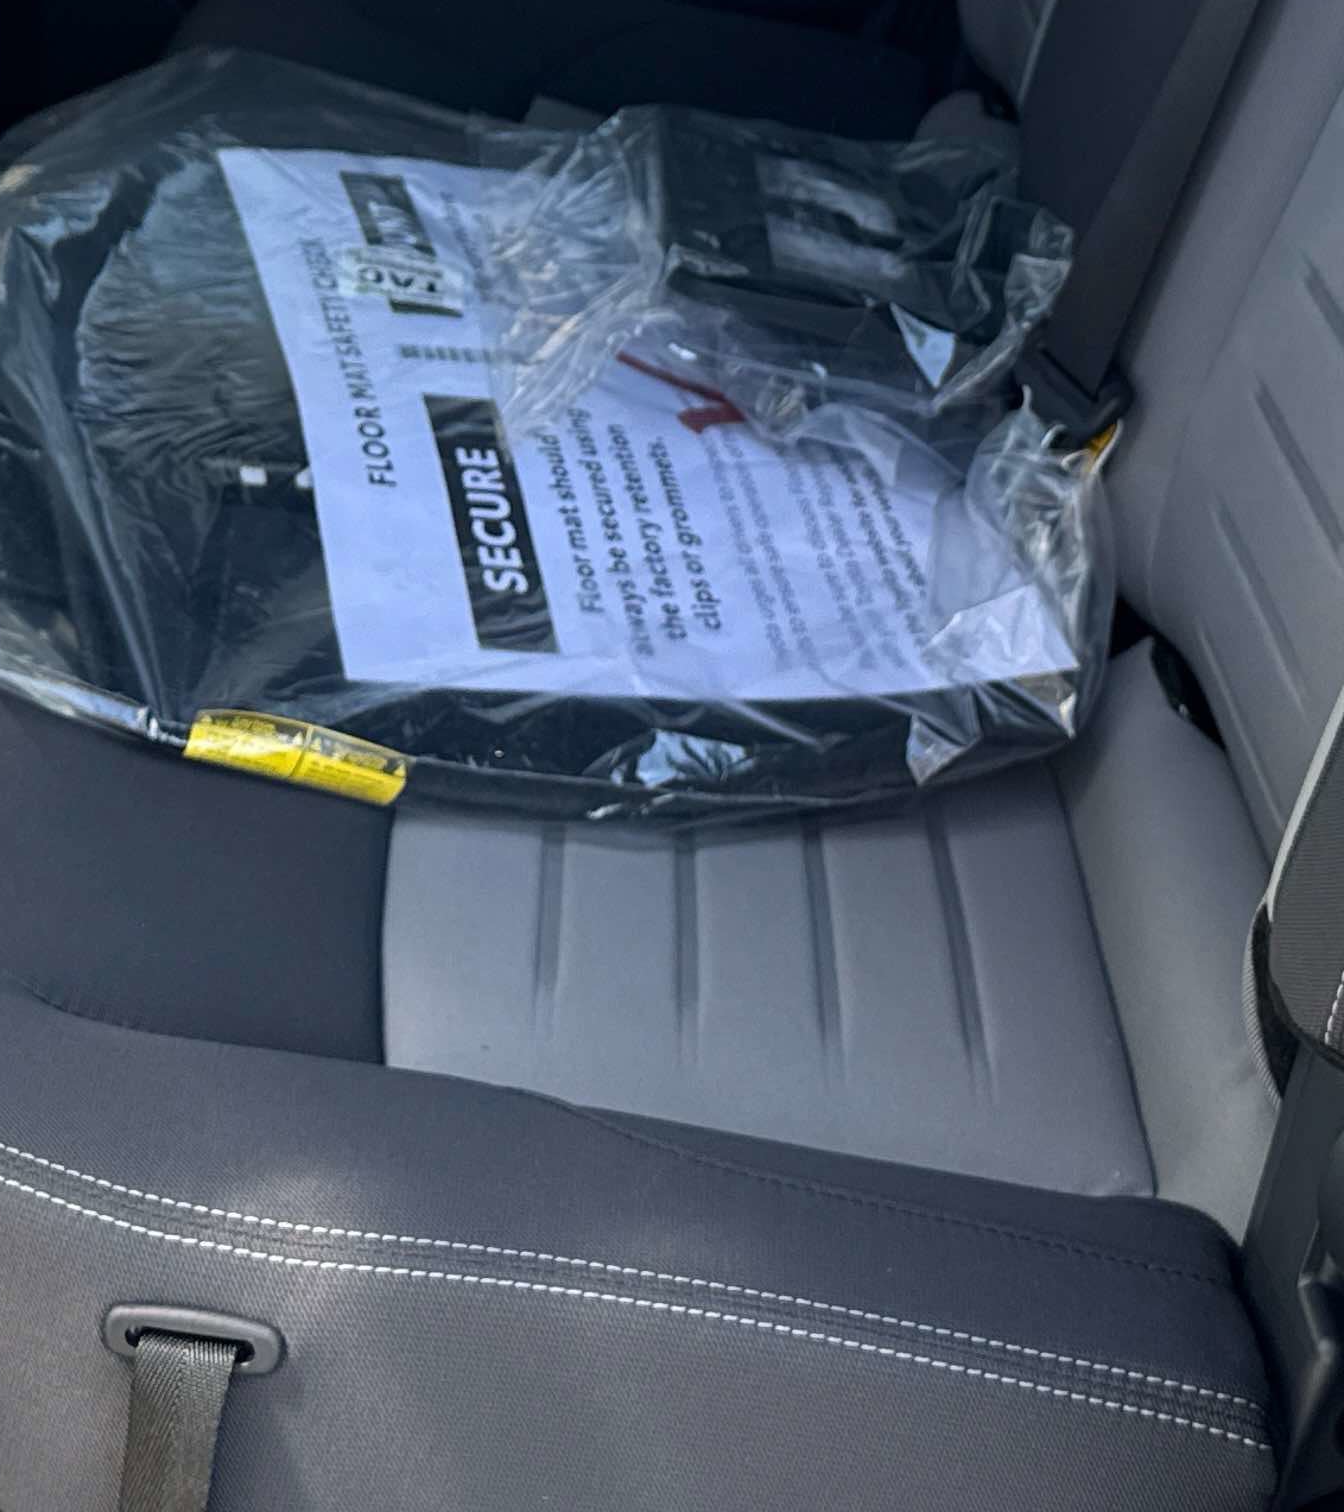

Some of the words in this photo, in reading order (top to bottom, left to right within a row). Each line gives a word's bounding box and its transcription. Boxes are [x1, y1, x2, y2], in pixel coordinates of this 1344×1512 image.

[339, 360, 377, 401] MAT
[354, 405, 397, 488] FLOOR
[567, 408, 598, 457] using
[538, 434, 577, 501] should
[608, 424, 652, 514] retention
[455, 447, 529, 595] SECURE
[558, 505, 588, 550] mat
[578, 460, 622, 542] secured
[574, 555, 604, 615] Floor
[606, 547, 631, 574] be
[636, 518, 673, 598] factory
[681, 551, 704, 575] or
[615, 579, 654, 658] always
[659, 603, 687, 641] the
[689, 578, 722, 631] clips
